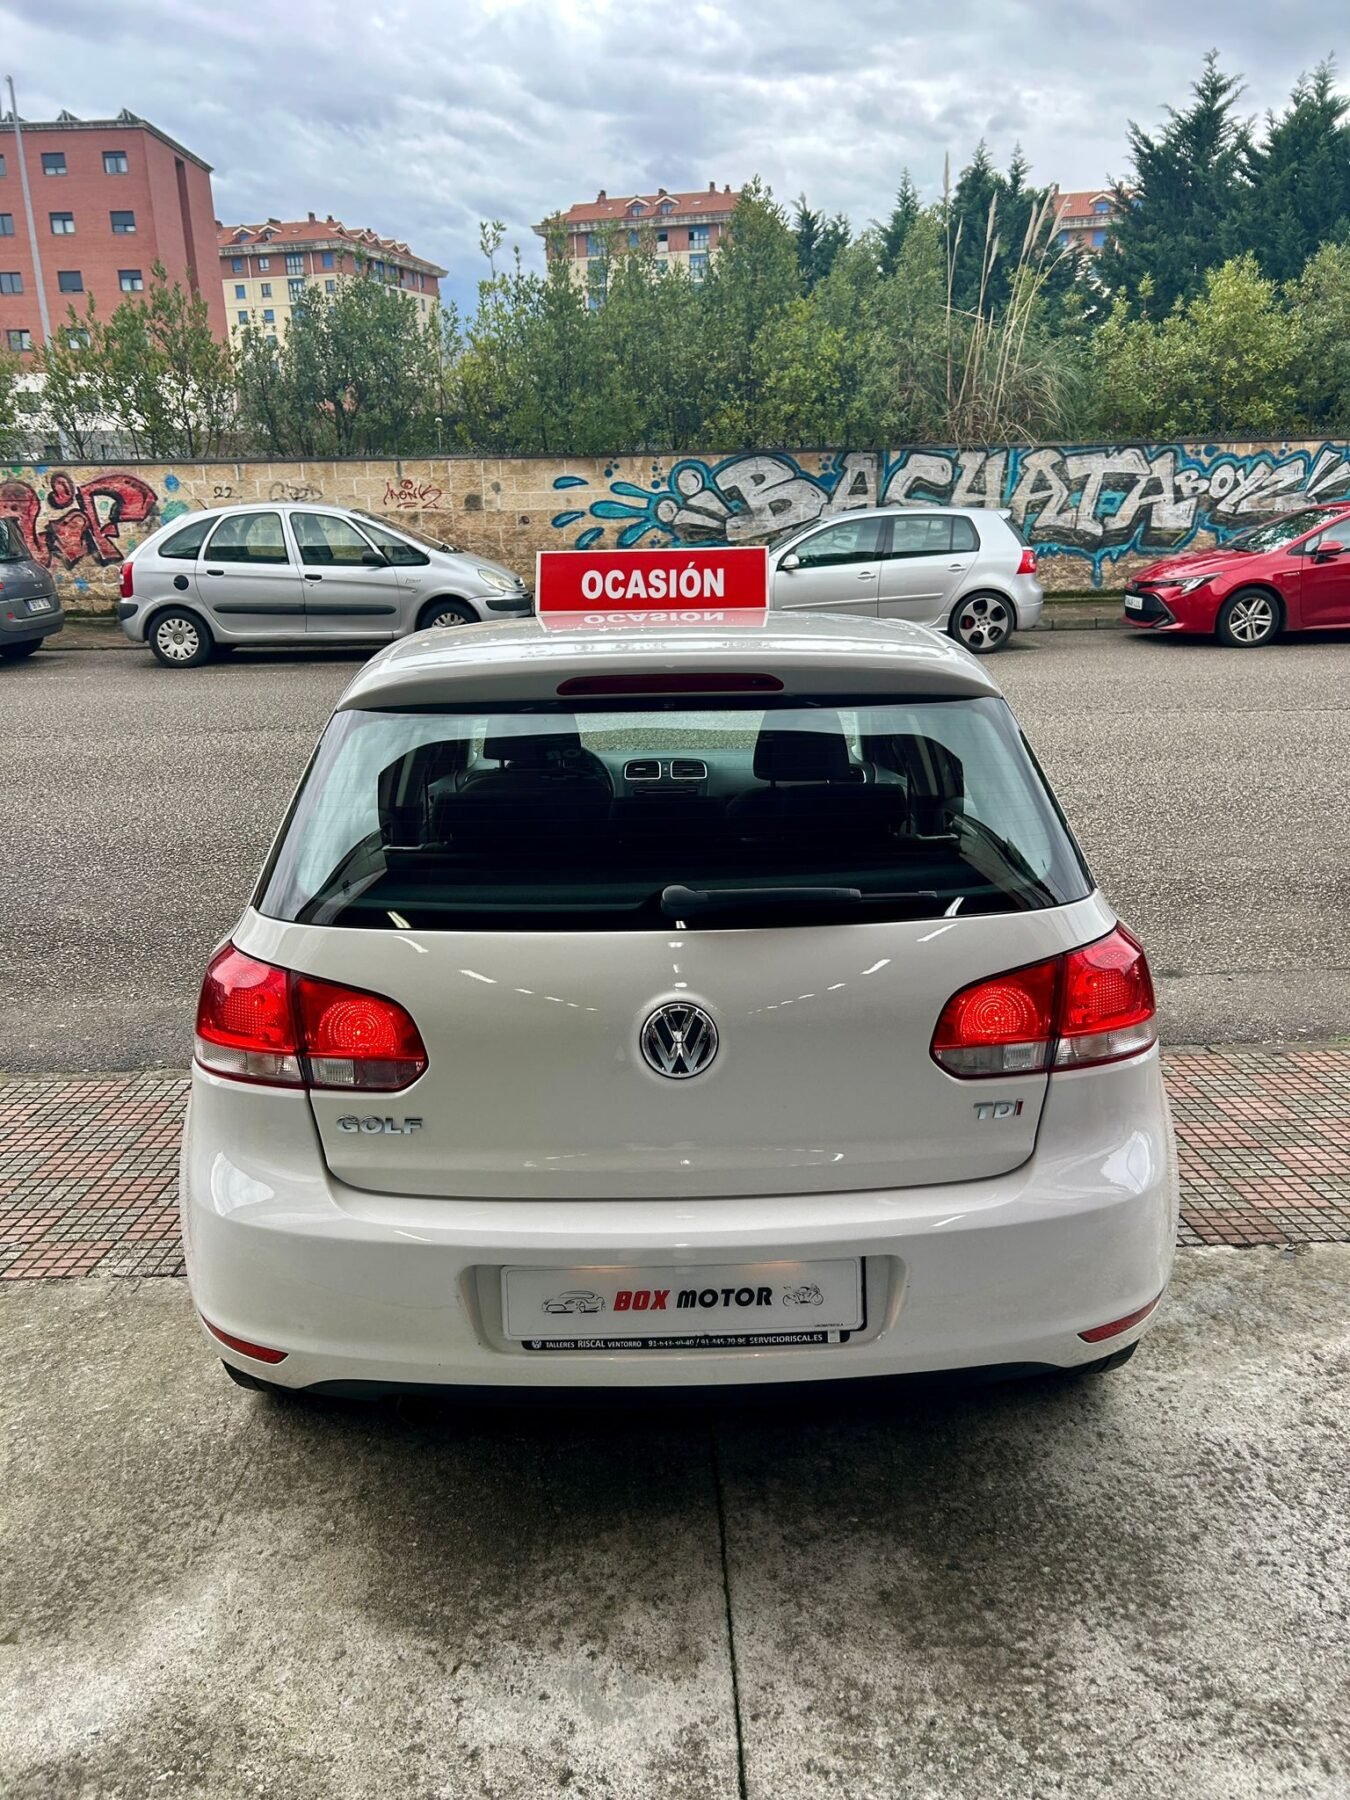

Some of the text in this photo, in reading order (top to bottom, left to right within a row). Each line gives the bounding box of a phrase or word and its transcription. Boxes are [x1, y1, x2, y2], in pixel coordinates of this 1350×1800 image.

[581, 561, 724, 599] OCASIÓN
[336, 1115, 423, 1134] GOLF
[613, 1287, 773, 1311] BOX MOTOR
[545, 1341, 575, 1349] TALLERES
[577, 1339, 606, 1348] RISCAL
[607, 1339, 642, 1348] VENTORRO
[750, 1334, 823, 1344] SERVICIORISCAL.ES
